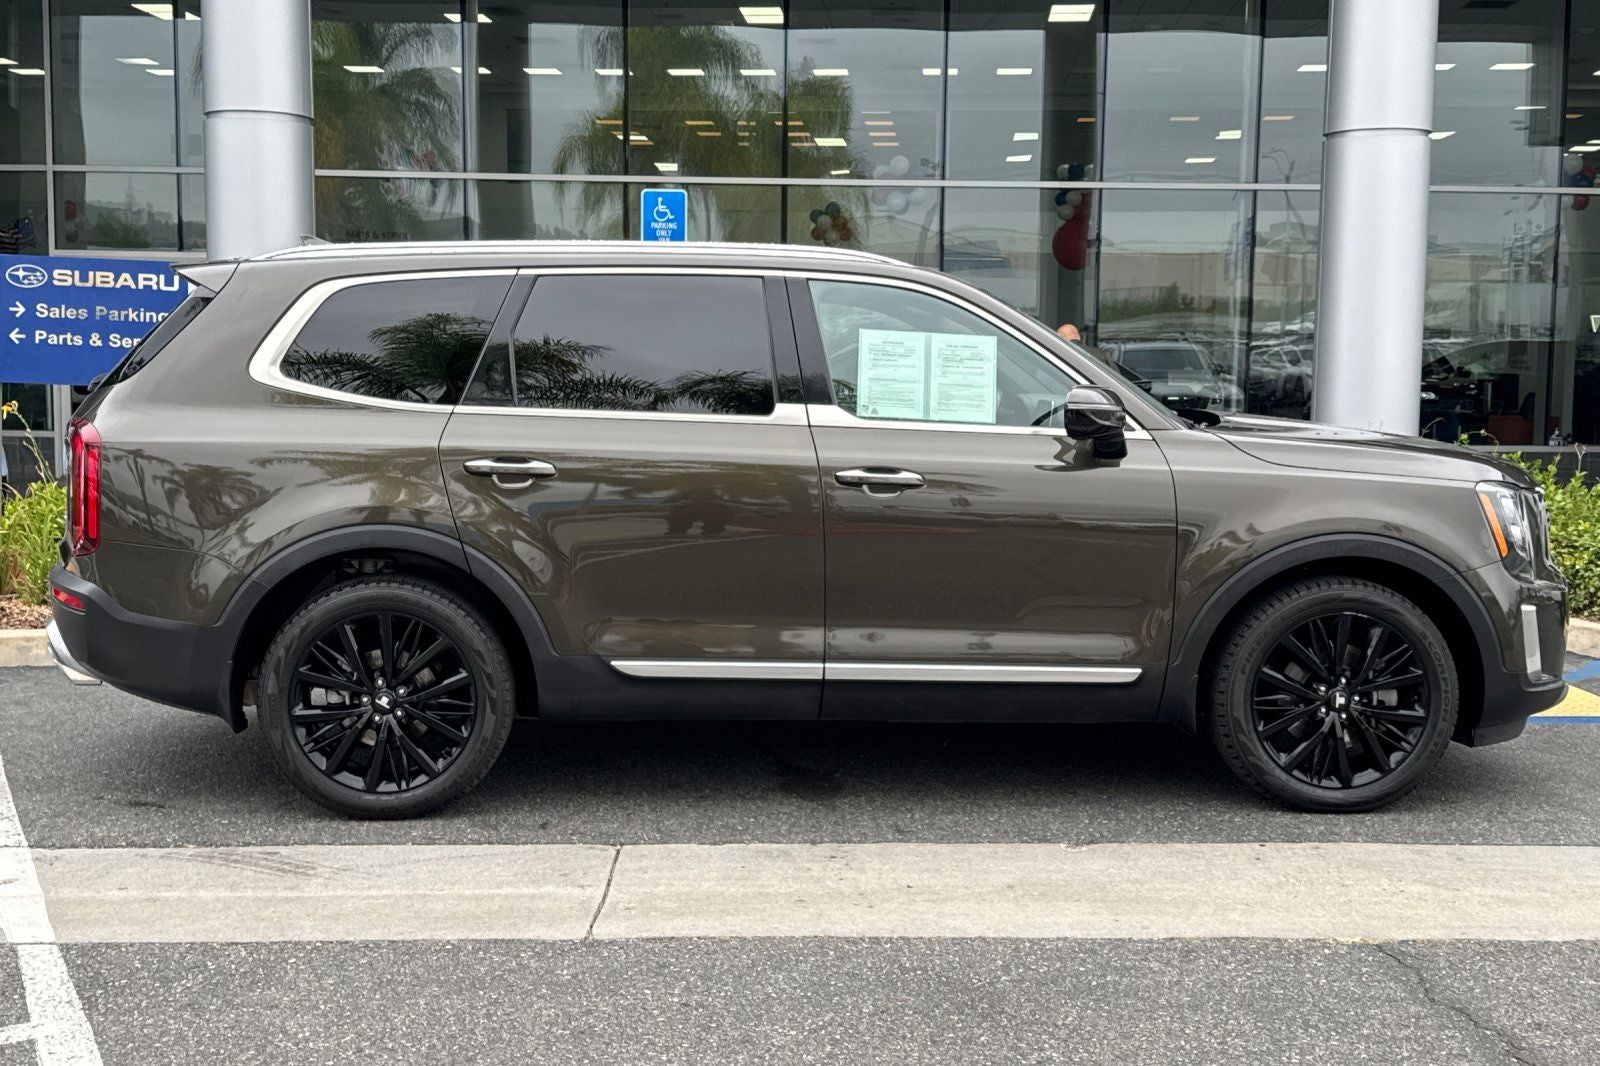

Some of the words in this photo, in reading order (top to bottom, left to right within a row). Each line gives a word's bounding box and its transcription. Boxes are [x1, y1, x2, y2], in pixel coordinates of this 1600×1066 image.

[650, 222, 677, 230] PARKING
[52, 269, 180, 292] SUBARU
[36, 303, 88, 320] Sales
[35, 330, 83, 346] Parts
[89, 333, 103, 347] &
[1421, 630, 1450, 723] SCORPION
